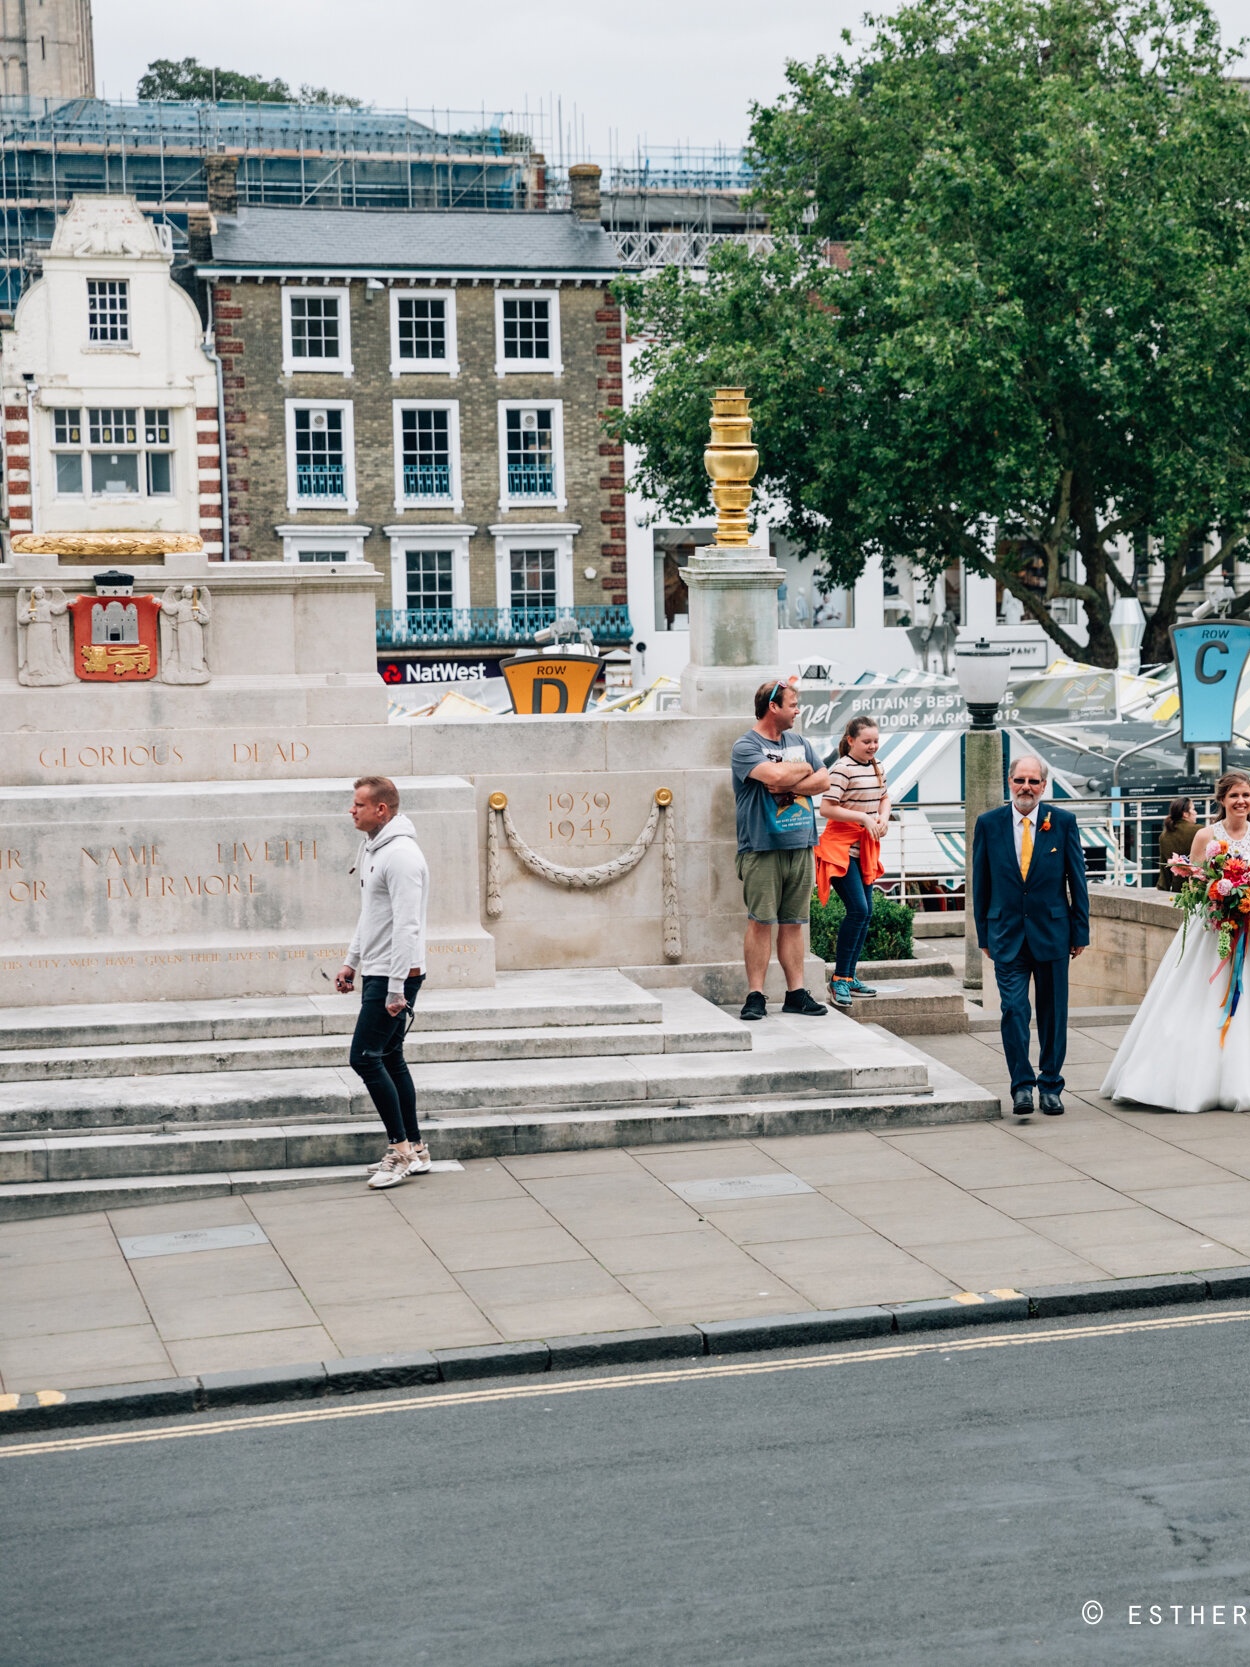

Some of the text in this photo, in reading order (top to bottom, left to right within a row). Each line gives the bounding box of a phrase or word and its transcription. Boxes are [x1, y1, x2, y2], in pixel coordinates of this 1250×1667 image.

[1202, 630, 1230, 639] ROW
[406, 662, 486, 682] NatWest
[537, 665, 567, 675] ROW
[1195, 640, 1229, 685] C
[532, 678, 569, 714] D
[852, 695, 963, 711] BRITAIN'S BEST
[800, 701, 842, 729] ner
[856, 709, 1020, 728] TDOOR MARKE 019
[39, 742, 310, 768] GLORIOUS DEAD
[549, 791, 610, 815] 1939
[549, 819, 611, 843] 1945
[0, 840, 318, 870] IR NAME LIVETH
[9, 873, 265, 901] OR EVERMORE
[29, 959, 61, 969] CITY
[69, 958, 99, 968] WHO
[105, 955, 136, 967] HAVE
[145, 954, 183, 966] GIVEN
[228, 951, 262, 962] LIVES
[268, 951, 279, 961] IN
[287, 950, 307, 960] THE
[314, 949, 348, 959] SERVIC
[428, 944, 479, 954] OUNTRY
